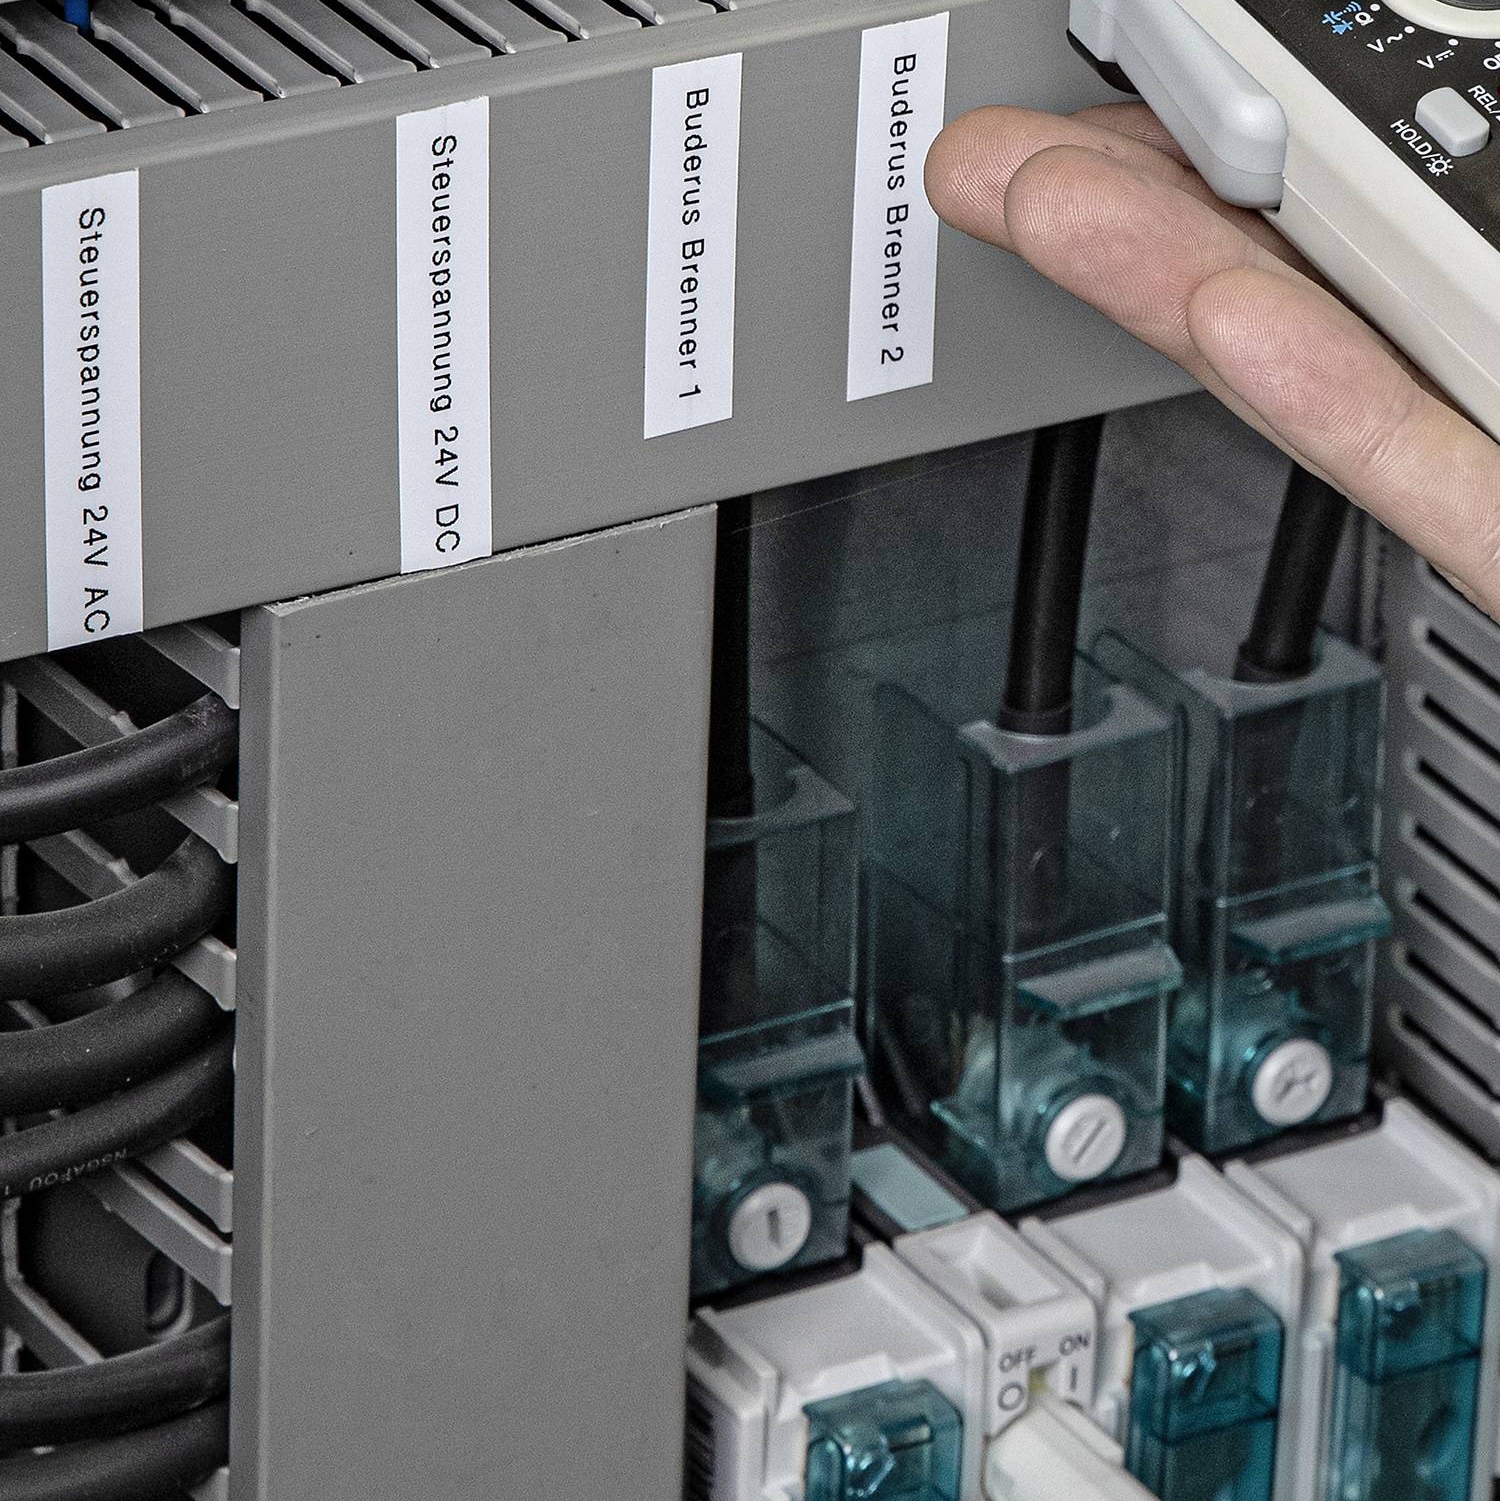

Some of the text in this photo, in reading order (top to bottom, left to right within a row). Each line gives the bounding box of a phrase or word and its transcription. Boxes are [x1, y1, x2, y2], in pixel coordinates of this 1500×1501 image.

[429, 135, 460, 553] Steuerspannung 24V DC
[679, 88, 709, 398] Buderus Brenner 1
[880, 53, 916, 364] Buderus Brenner 2
[78, 206, 109, 633] Steuerspannung 24V AC
[1059, 1330, 1092, 1356] ON
